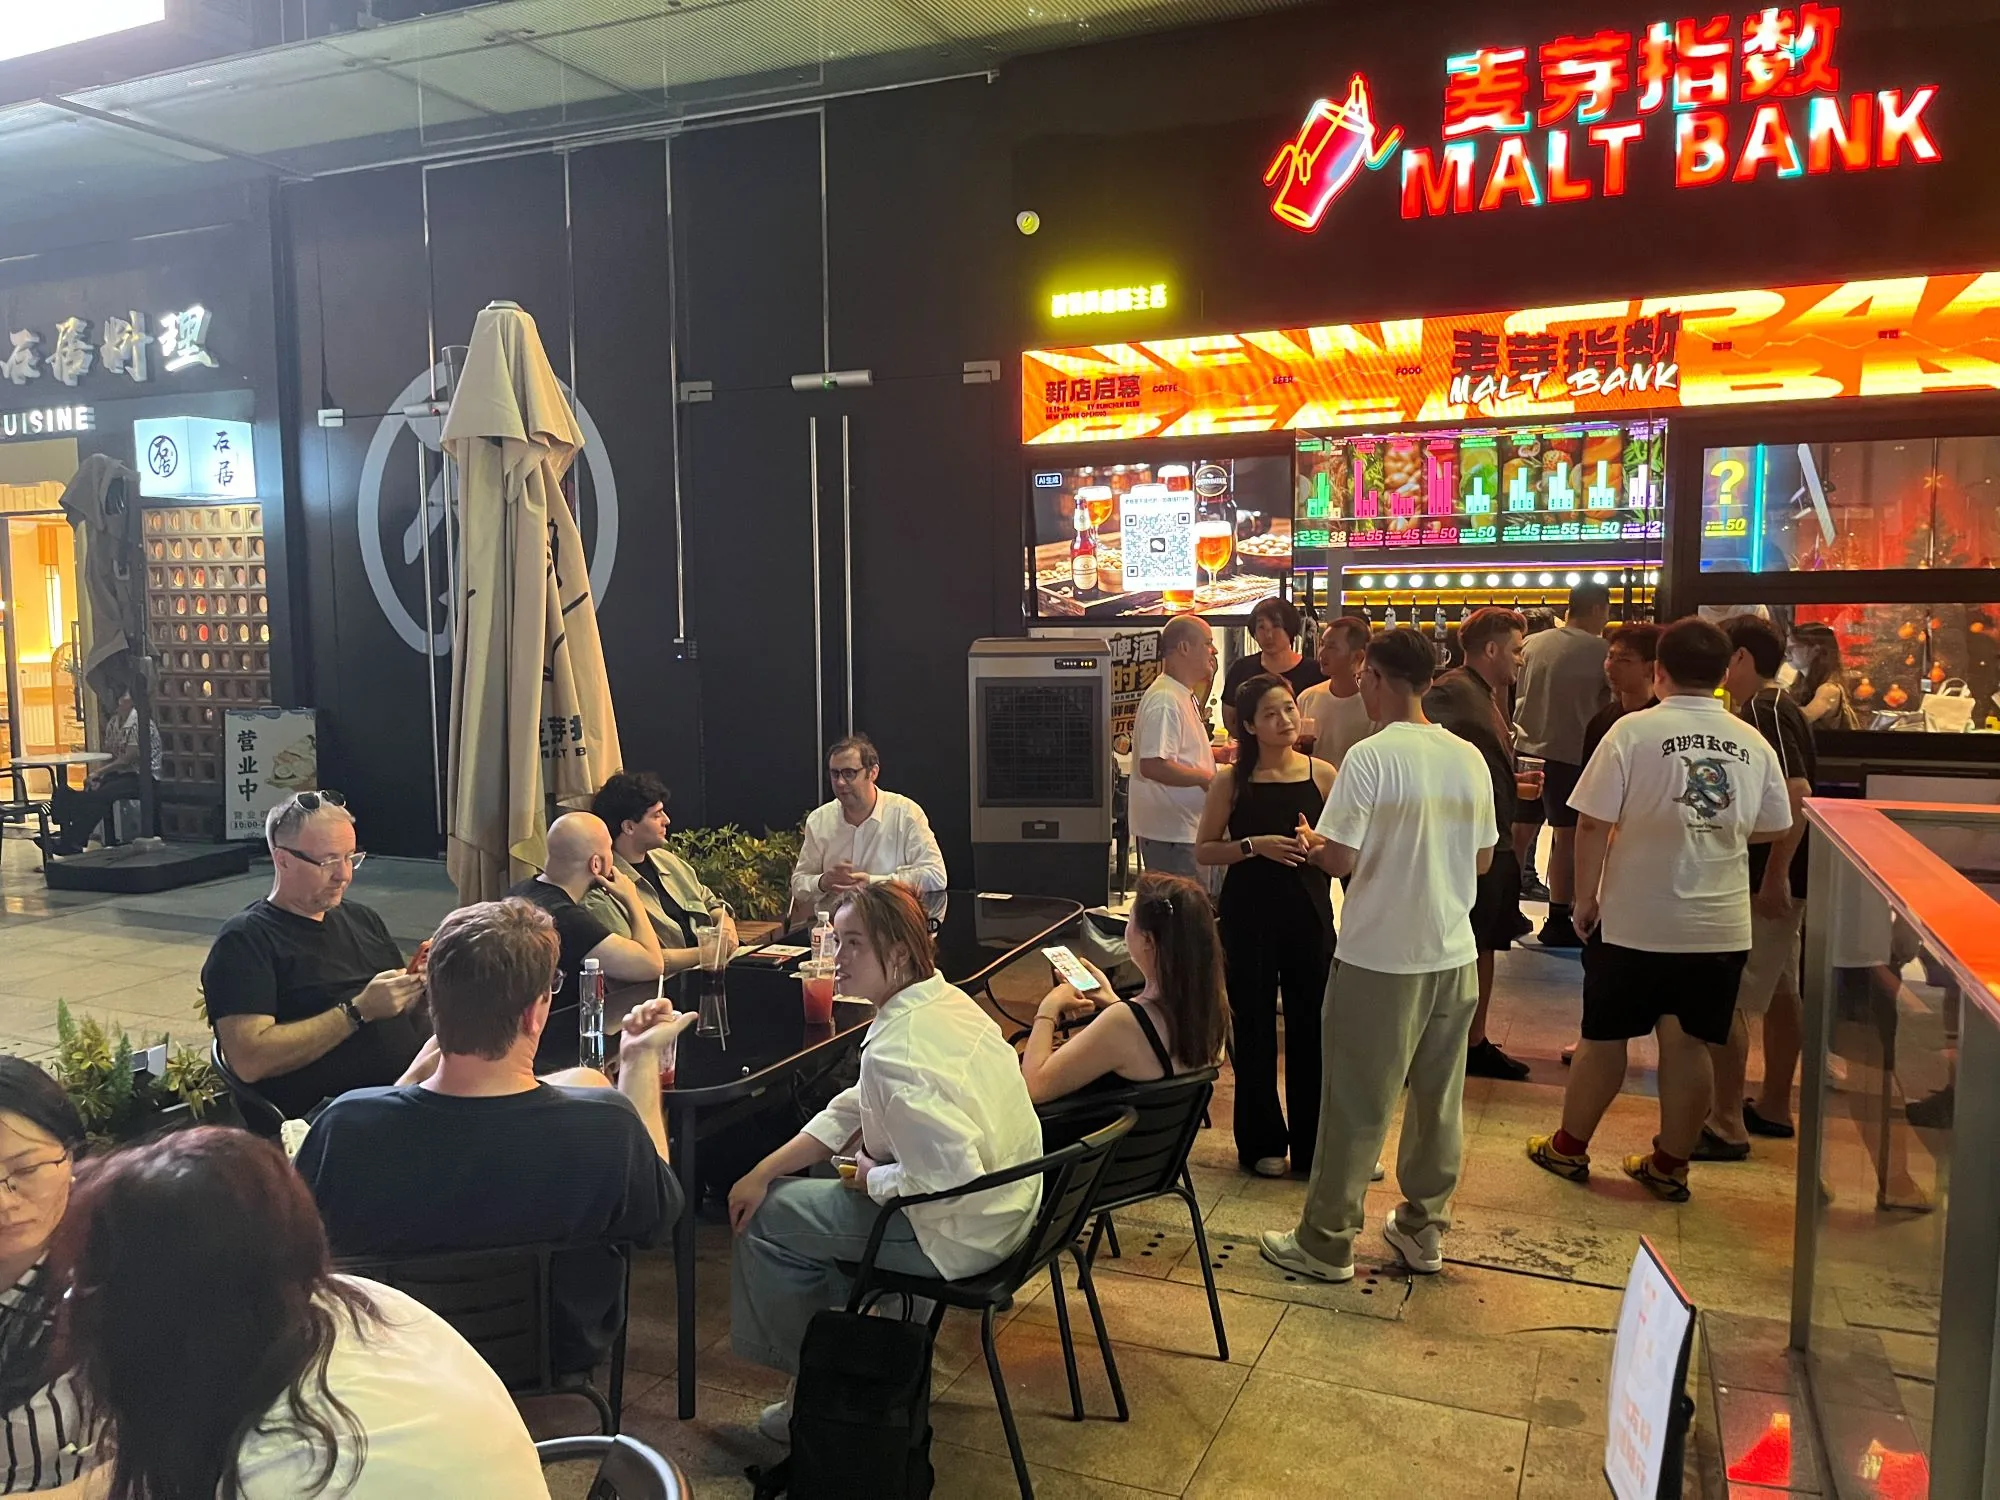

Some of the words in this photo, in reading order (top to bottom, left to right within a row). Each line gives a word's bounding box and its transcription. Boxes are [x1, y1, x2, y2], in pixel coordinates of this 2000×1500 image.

[1443, 5, 1842, 137] 麦芽指数
[1400, 120, 1646, 219] MALT
[1675, 85, 1943, 190] BANK
[1452, 308, 1682, 394] 麦芽指数
[1395, 366, 1422, 376] FOOD
[1046, 374, 1141, 403] 新店启幕
[1450, 371, 1551, 404] MALT
[1566, 361, 1680, 398] BANK
[213, 431, 234, 487] 石居
[1521, 523, 1540, 536] 45
[1561, 522, 1580, 535] 55
[1600, 521, 1620, 534] 50
[1726, 518, 1747, 531] 50
[1366, 529, 1383, 541] 55
[1402, 528, 1420, 540] 45
[1440, 527, 1457, 539] 50
[1478, 526, 1496, 538] 50
[1110, 633, 1158, 664] 啤酒
[237, 730, 259, 802] 营业中
